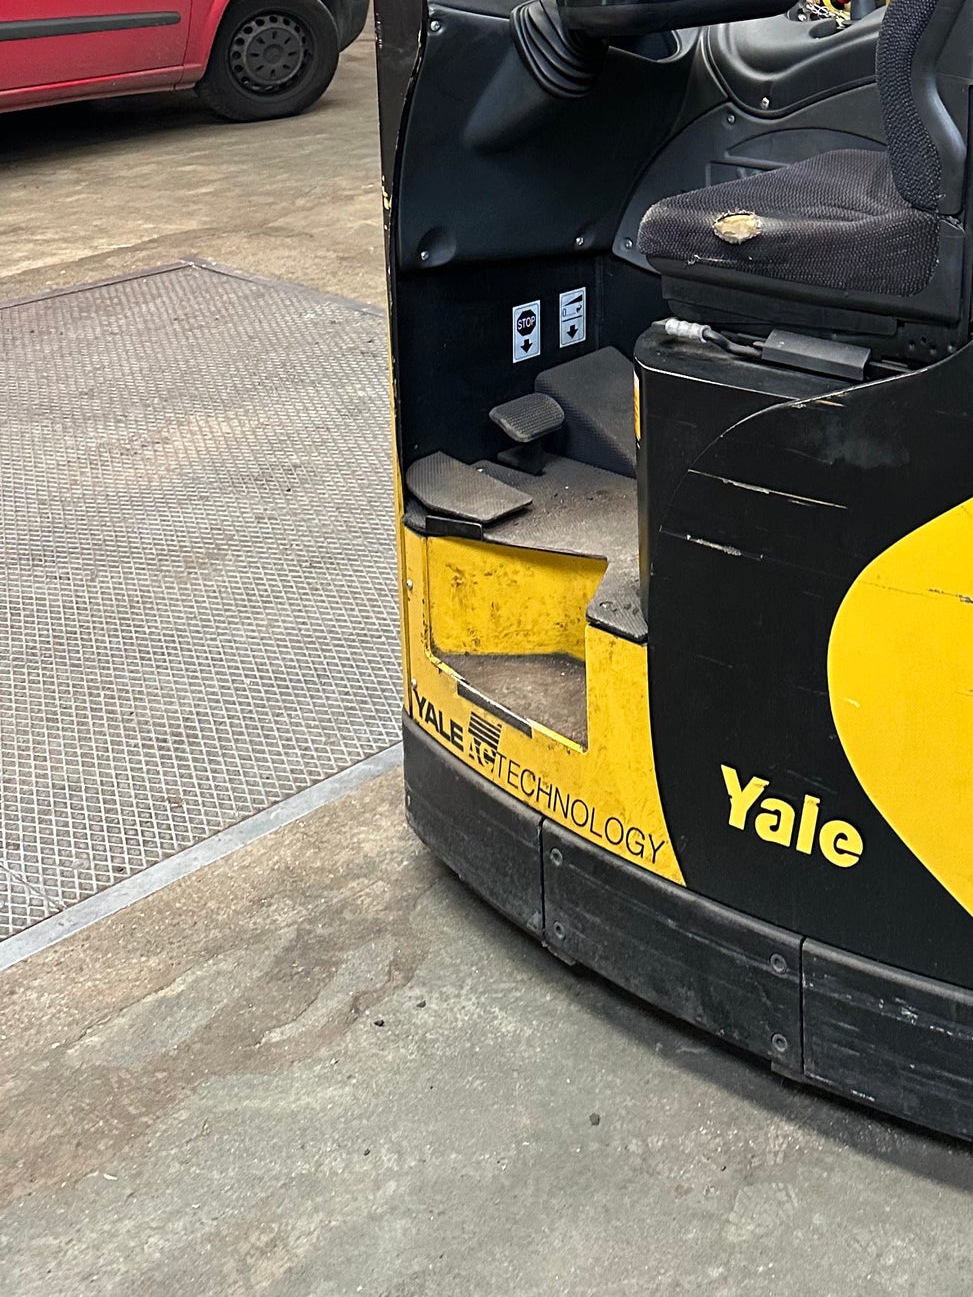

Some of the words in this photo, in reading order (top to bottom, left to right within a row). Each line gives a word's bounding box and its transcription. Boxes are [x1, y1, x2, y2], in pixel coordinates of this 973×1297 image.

[517, 315, 536, 330] STOP
[412, 689, 464, 752] YALE
[496, 751, 666, 864] TECHNOLOGY
[720, 764, 864, 868] Yale
